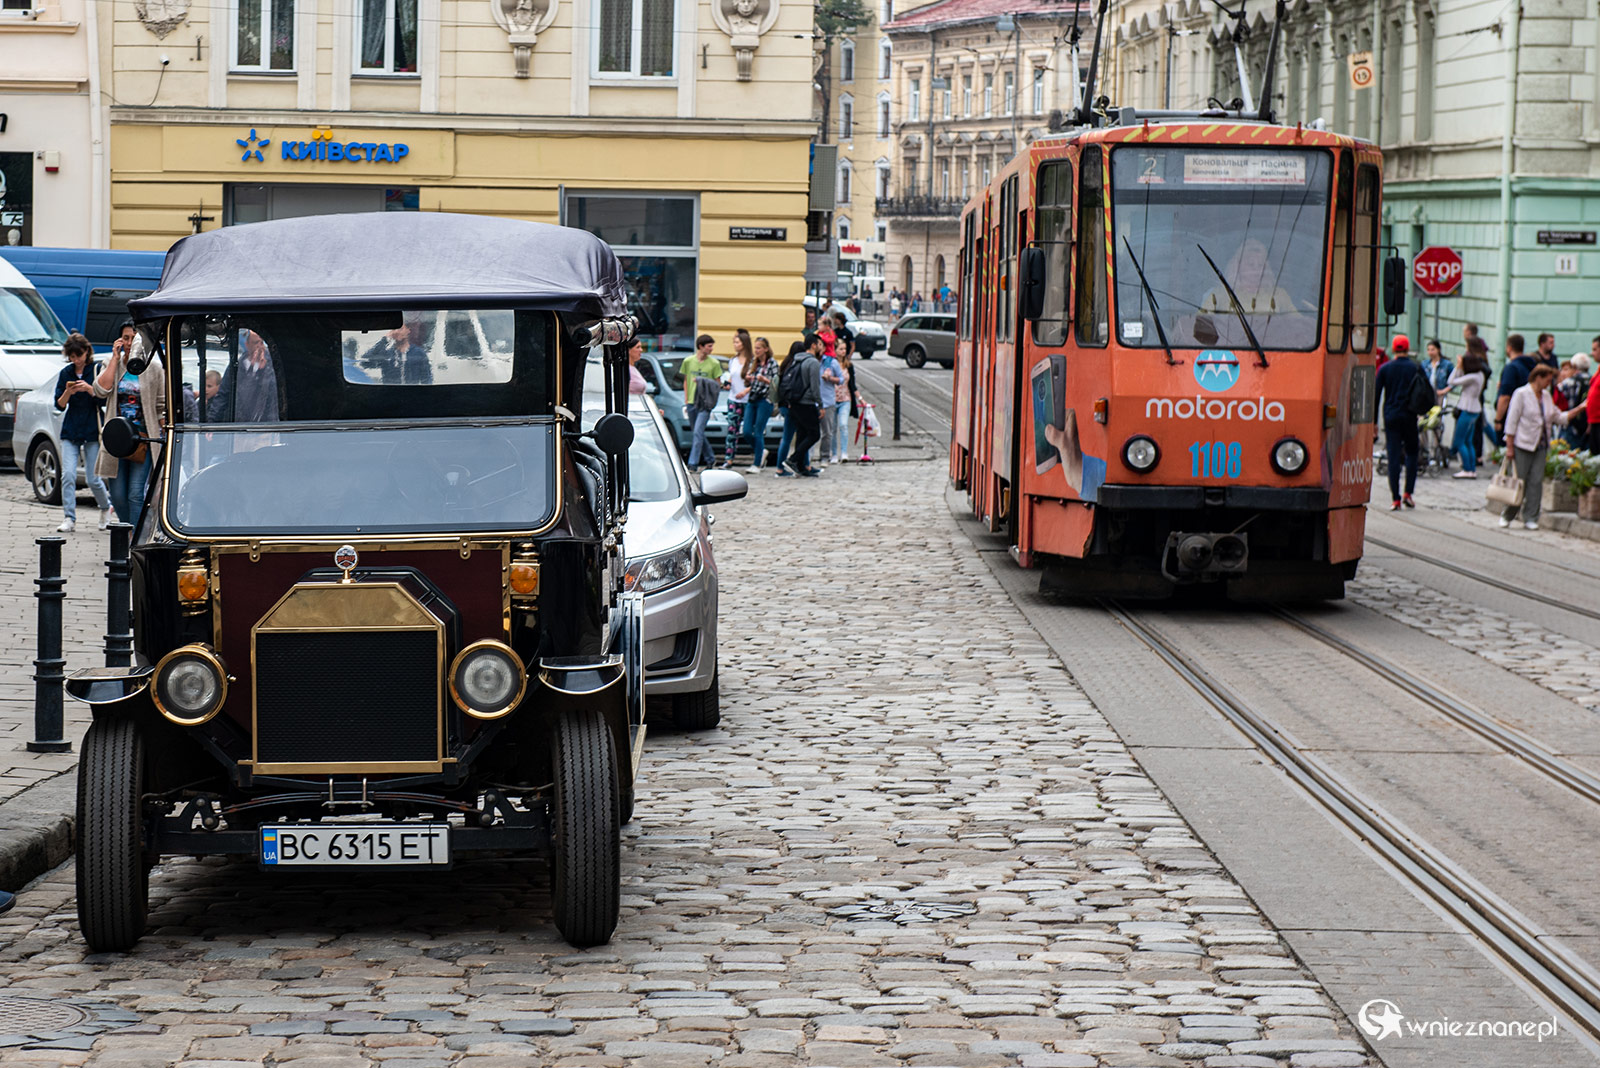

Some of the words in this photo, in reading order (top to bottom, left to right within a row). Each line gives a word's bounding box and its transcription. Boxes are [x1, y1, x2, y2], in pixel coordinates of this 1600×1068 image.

[1143, 157, 1157, 175] 2
[1416, 262, 1461, 279] STOP
[1145, 394, 1286, 421] motorola
[1188, 441, 1242, 478] 1108
[263, 852, 277, 861] UA
[280, 833, 319, 861] BC
[328, 833, 391, 860] 6315
[400, 833, 440, 860] ET
